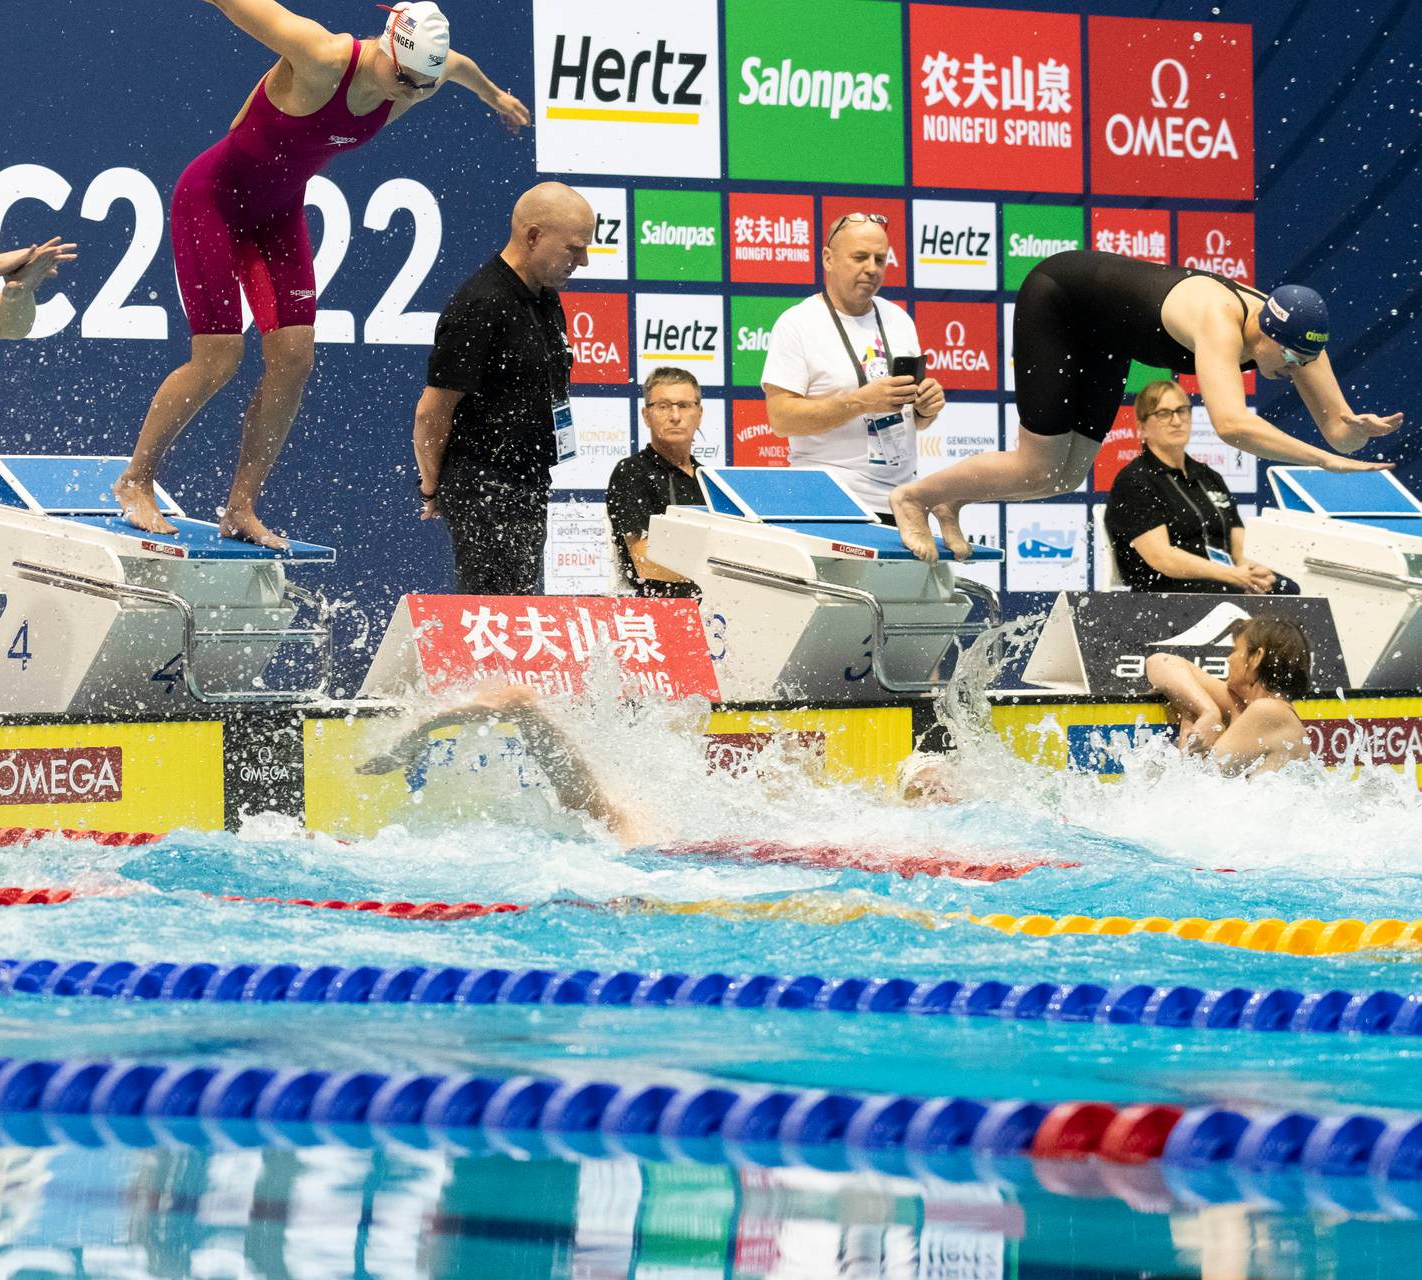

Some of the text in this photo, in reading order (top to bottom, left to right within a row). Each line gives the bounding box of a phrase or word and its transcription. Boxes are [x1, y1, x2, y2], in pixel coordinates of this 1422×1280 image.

[548, 34, 707, 106] Hertz
[921, 51, 1072, 114] 农夫山泉
[738, 56, 891, 119] Salonpas
[923, 114, 1072, 148] NONGFU SPRING
[1105, 113, 1239, 160] OMEGA
[640, 220, 715, 251] Salonpas
[734, 215, 810, 246] 农夫山泉
[920, 224, 991, 257] Hertz
[1096, 229, 1166, 258] 农夫山泉
[735, 247, 810, 262] NONGFU SPRING
[643, 318, 718, 352] Hertz
[572, 342, 621, 364] EGA
[924, 348, 990, 372] OMEGA
[579, 445, 627, 457] STIFTUNG
[558, 553, 595, 566] BERLIN
[7, 619, 33, 671] 4
[460, 605, 667, 663] 农夫山泉
[240, 766, 290, 782] OMEGA
